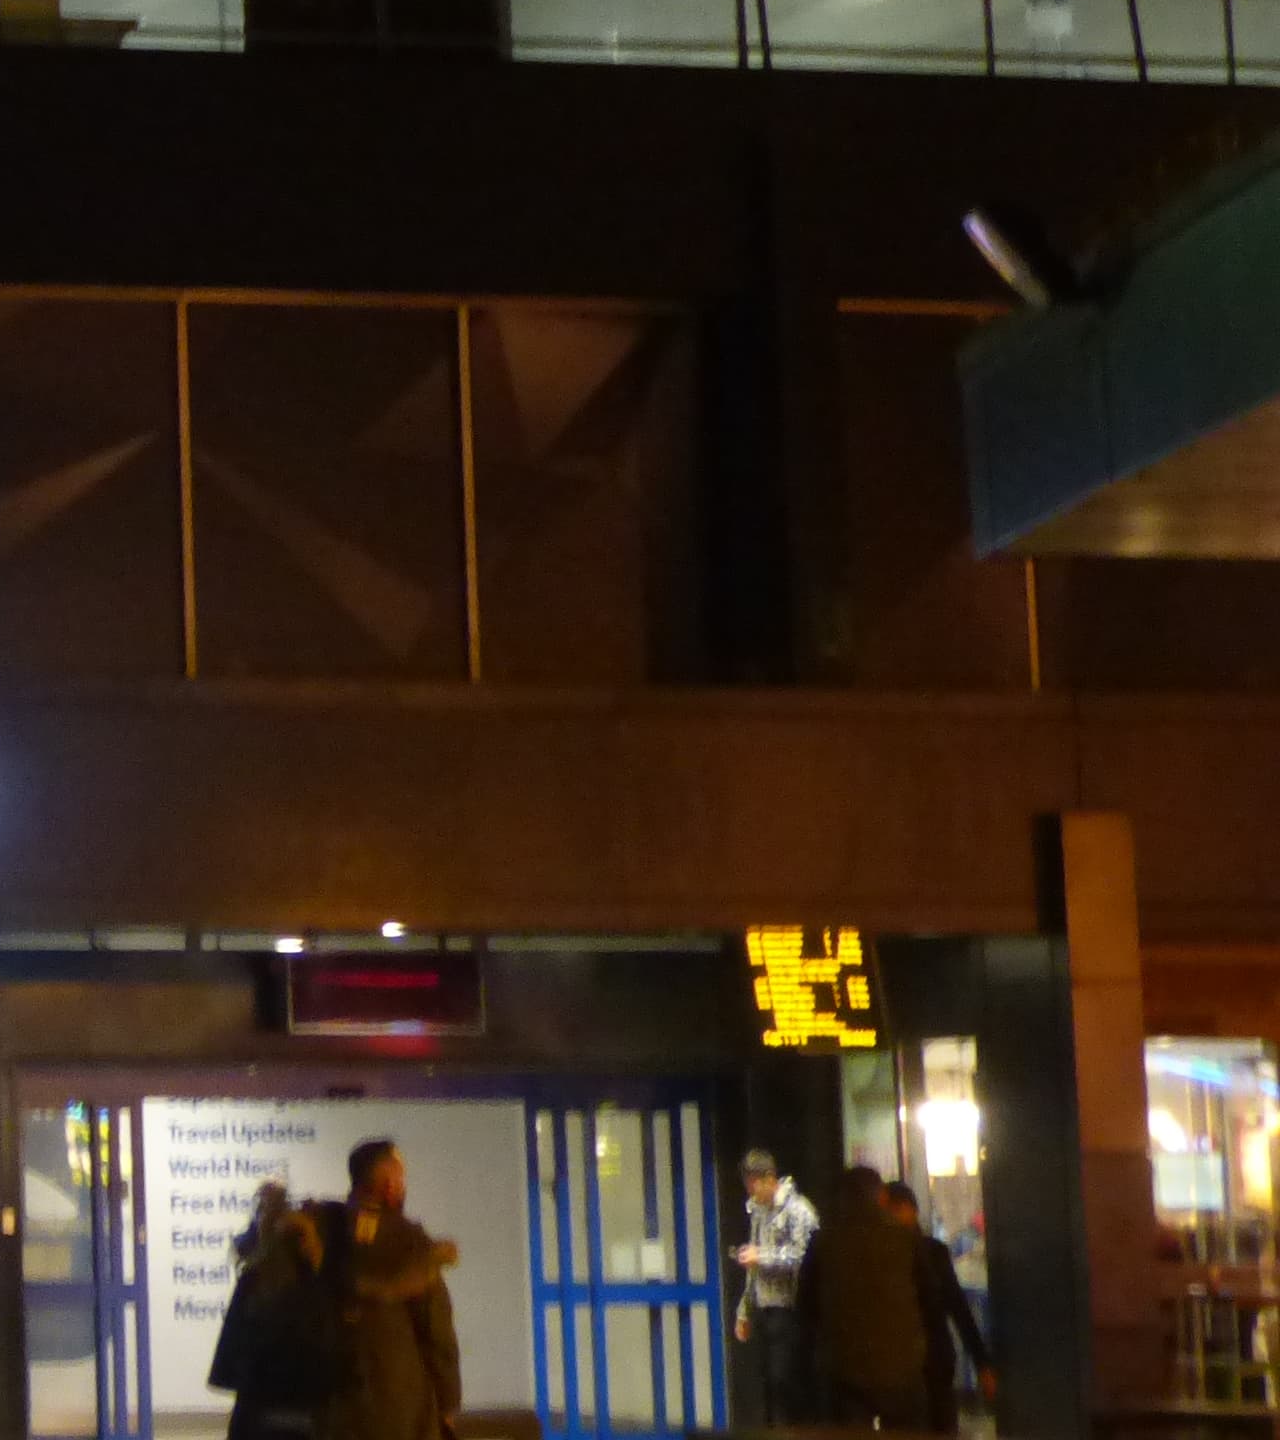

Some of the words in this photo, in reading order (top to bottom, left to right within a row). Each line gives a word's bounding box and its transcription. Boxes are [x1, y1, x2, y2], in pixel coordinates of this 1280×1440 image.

[168, 1122, 227, 1143] Travel
[232, 1122, 316, 1147] Updates
[168, 1157, 230, 1178] World
[170, 1193, 216, 1212] Free
[172, 1264, 232, 1284] Retail
